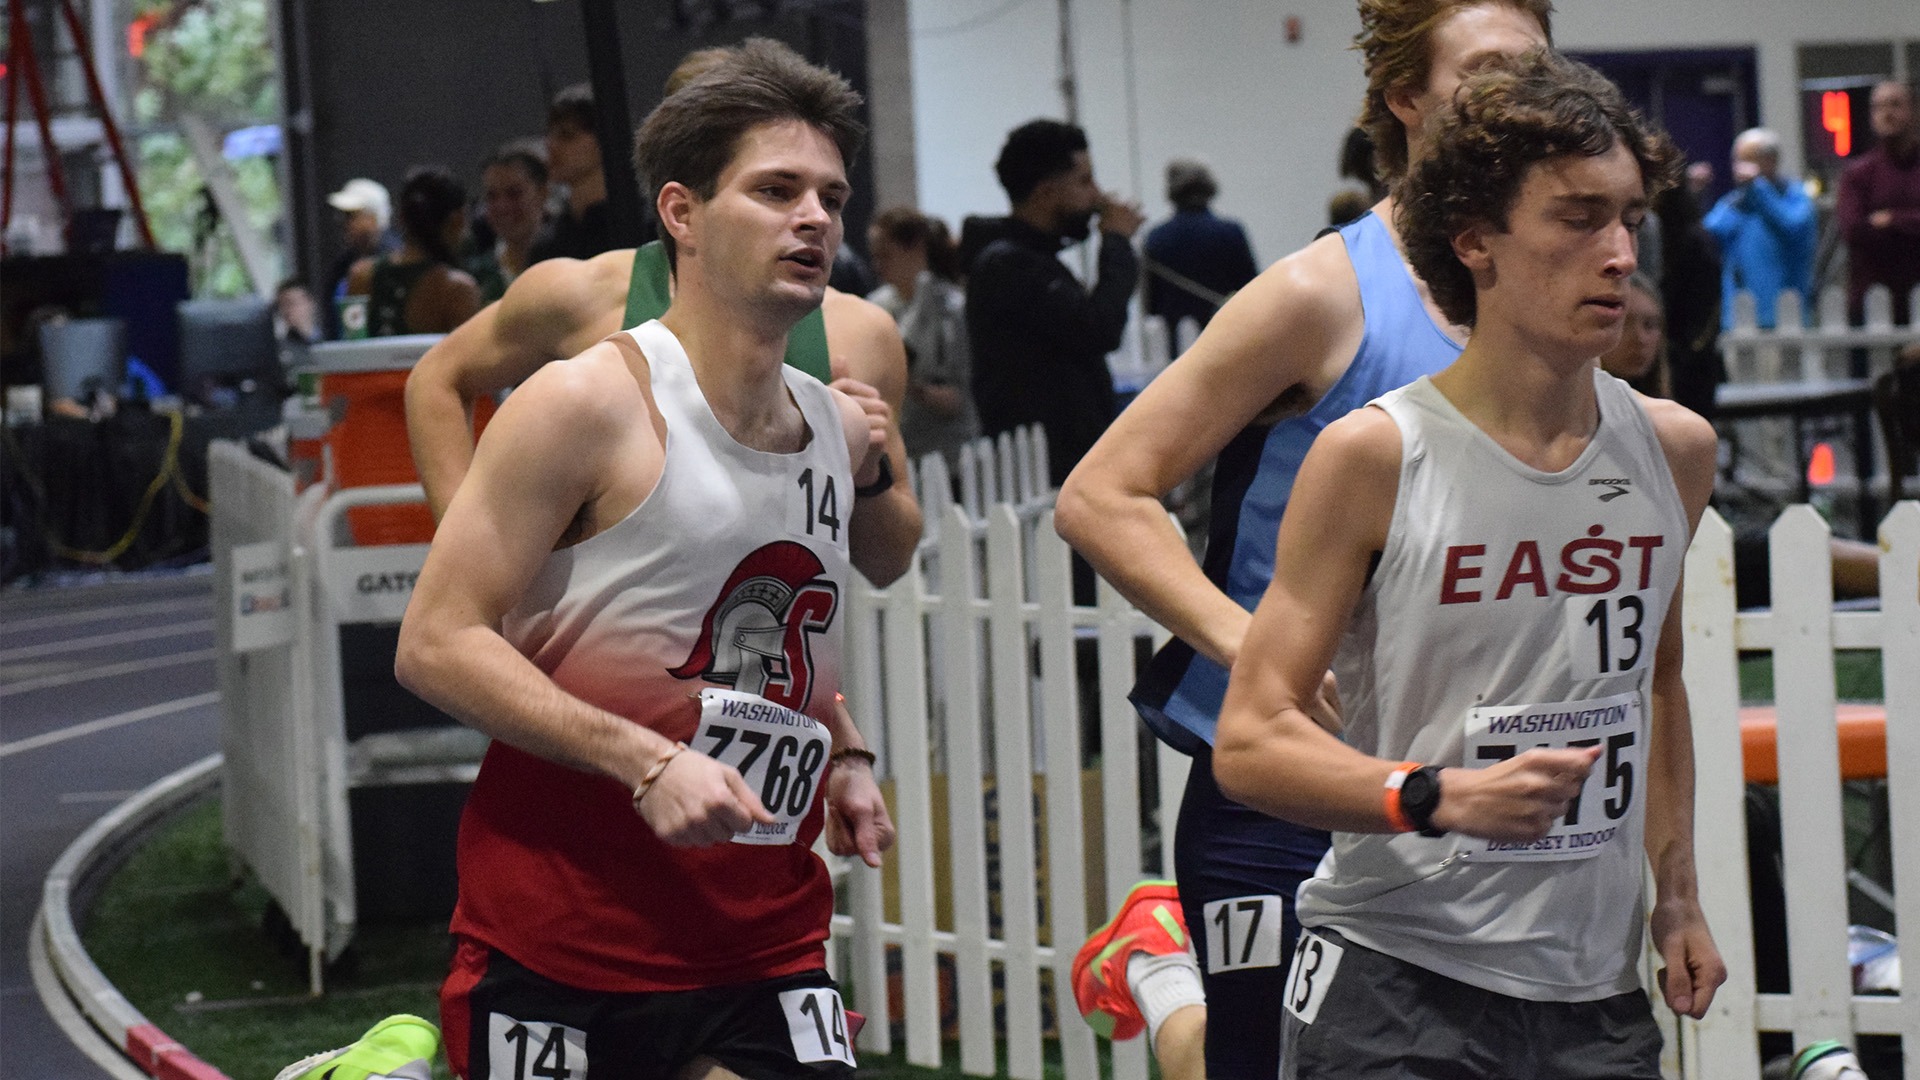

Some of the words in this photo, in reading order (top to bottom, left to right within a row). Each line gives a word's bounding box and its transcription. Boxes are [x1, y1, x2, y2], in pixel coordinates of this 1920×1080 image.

[798, 467, 840, 541] 14
[1588, 477, 1631, 486] BROOKS
[1439, 524, 1664, 605] EAST
[1585, 595, 1645, 673] 13
[722, 699, 818, 729] WASHINGTON
[1488, 704, 1628, 734] WASHINGTON
[705, 724, 824, 817] 7768
[1477, 731, 1635, 826] 75
[1214, 900, 1264, 966] 17
[1291, 935, 1322, 1013] 13
[504, 1023, 571, 1080] 14
[800, 993, 848, 1060] 14
